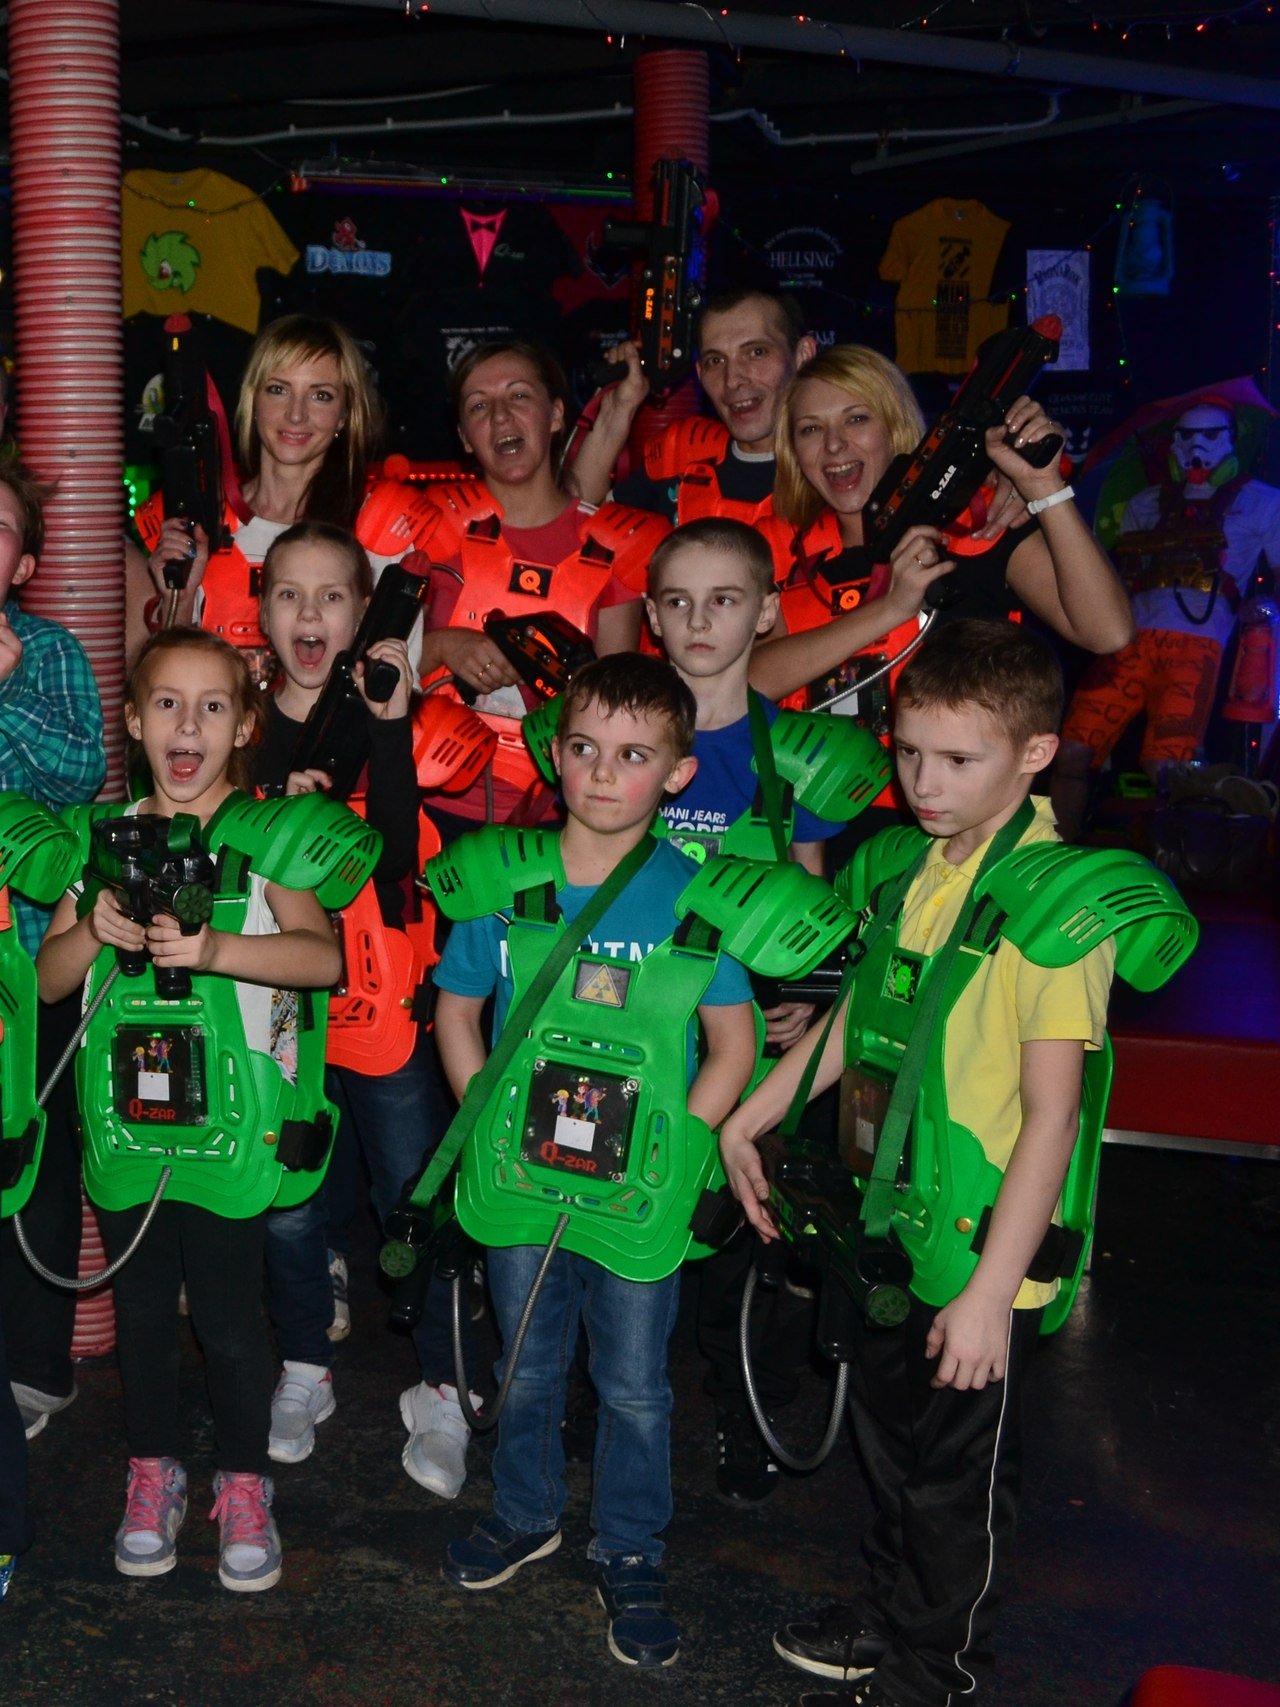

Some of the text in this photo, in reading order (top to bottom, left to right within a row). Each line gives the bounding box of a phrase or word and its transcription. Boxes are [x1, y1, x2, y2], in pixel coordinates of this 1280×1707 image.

[770, 250, 835, 268] HELLSING
[644, 287, 655, 320] Q-ZAR
[930, 464, 958, 500] Q-ZAR
[519, 569, 542, 595] Q
